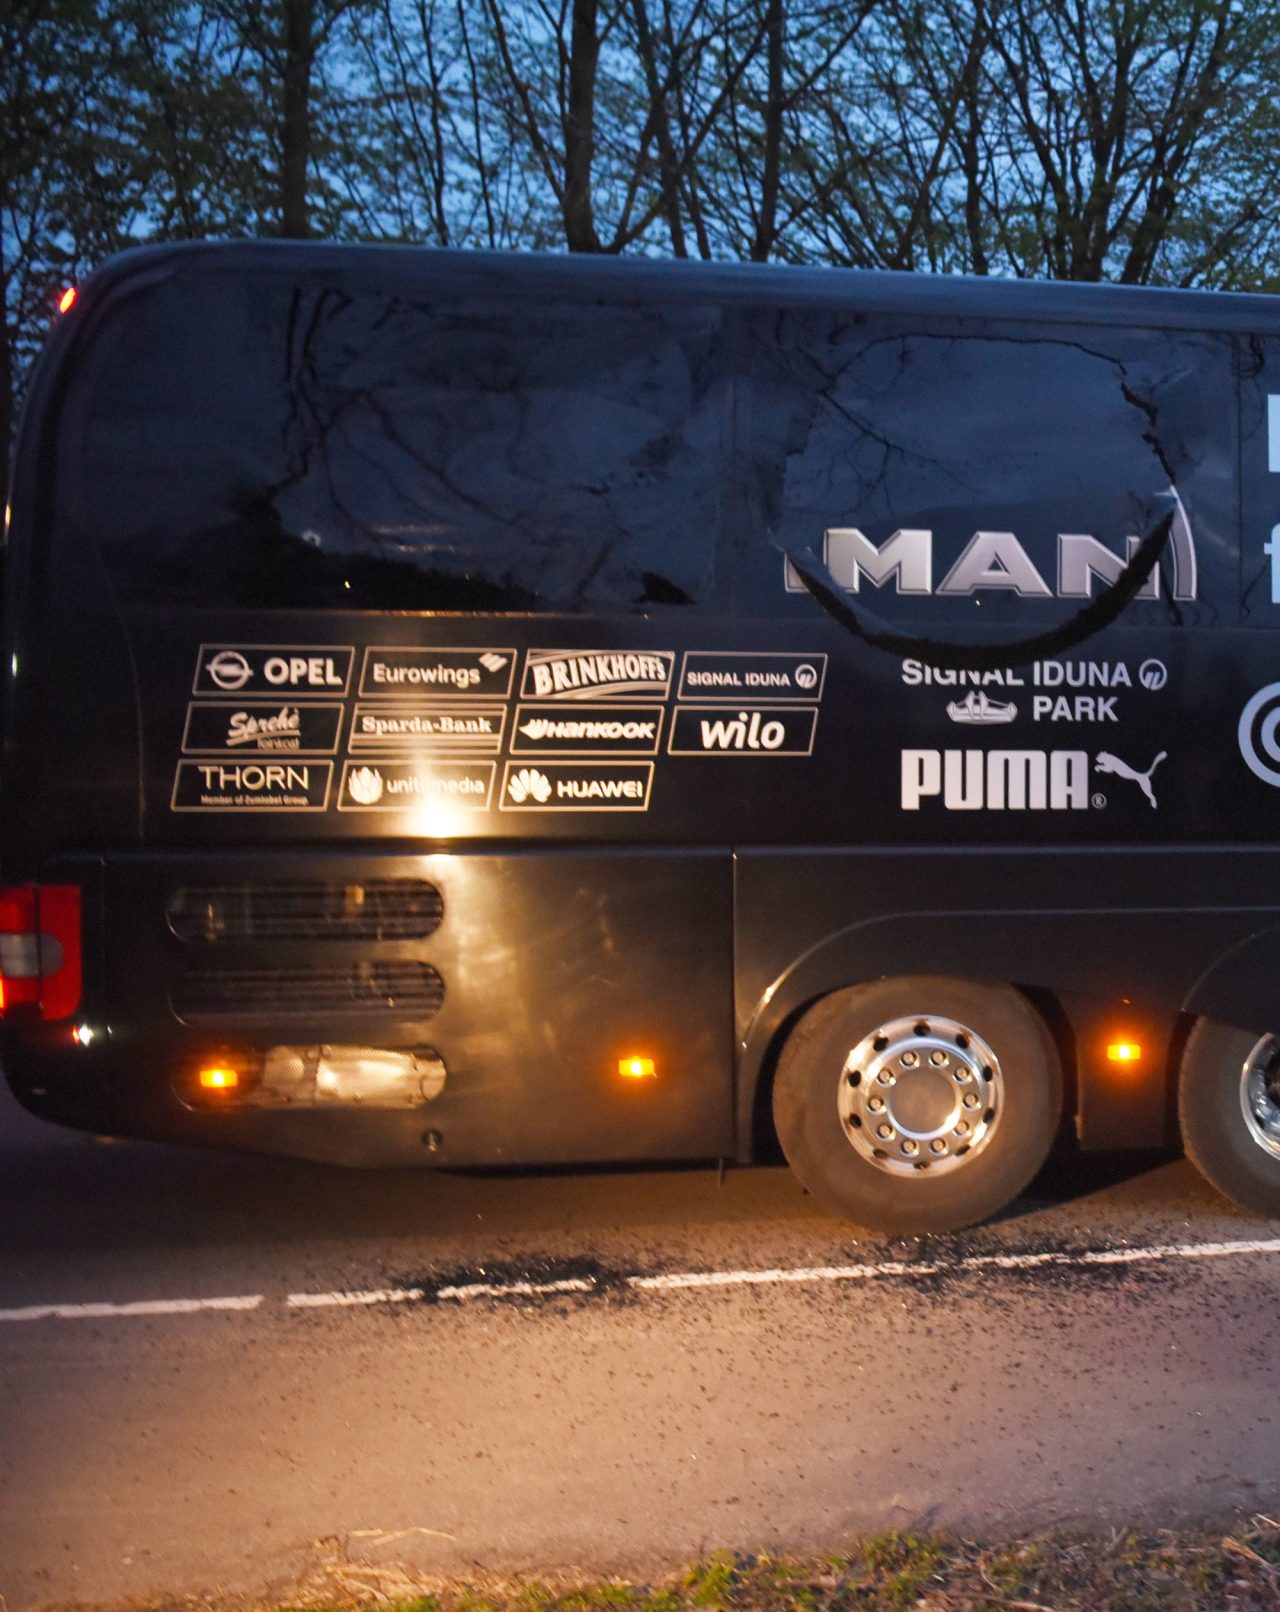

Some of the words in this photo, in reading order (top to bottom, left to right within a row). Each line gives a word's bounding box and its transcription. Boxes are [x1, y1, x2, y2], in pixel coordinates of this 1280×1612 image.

[823, 528, 1160, 599] MAN
[263, 657, 343, 685] OPEL
[373, 662, 481, 689] Eurowings
[687, 671, 742, 687] SIGNAL
[745, 674, 791, 687] IDUNA
[902, 658, 1024, 686] SIGNAL
[1033, 660, 1133, 688] IDUNA
[1033, 696, 1120, 722] PARK
[362, 716, 492, 735] Sparda-Bank
[700, 712, 785, 749] wilo
[198, 766, 309, 790] THORN
[557, 781, 643, 798] HUAWEI
[901, 749, 1089, 810] PUMA
